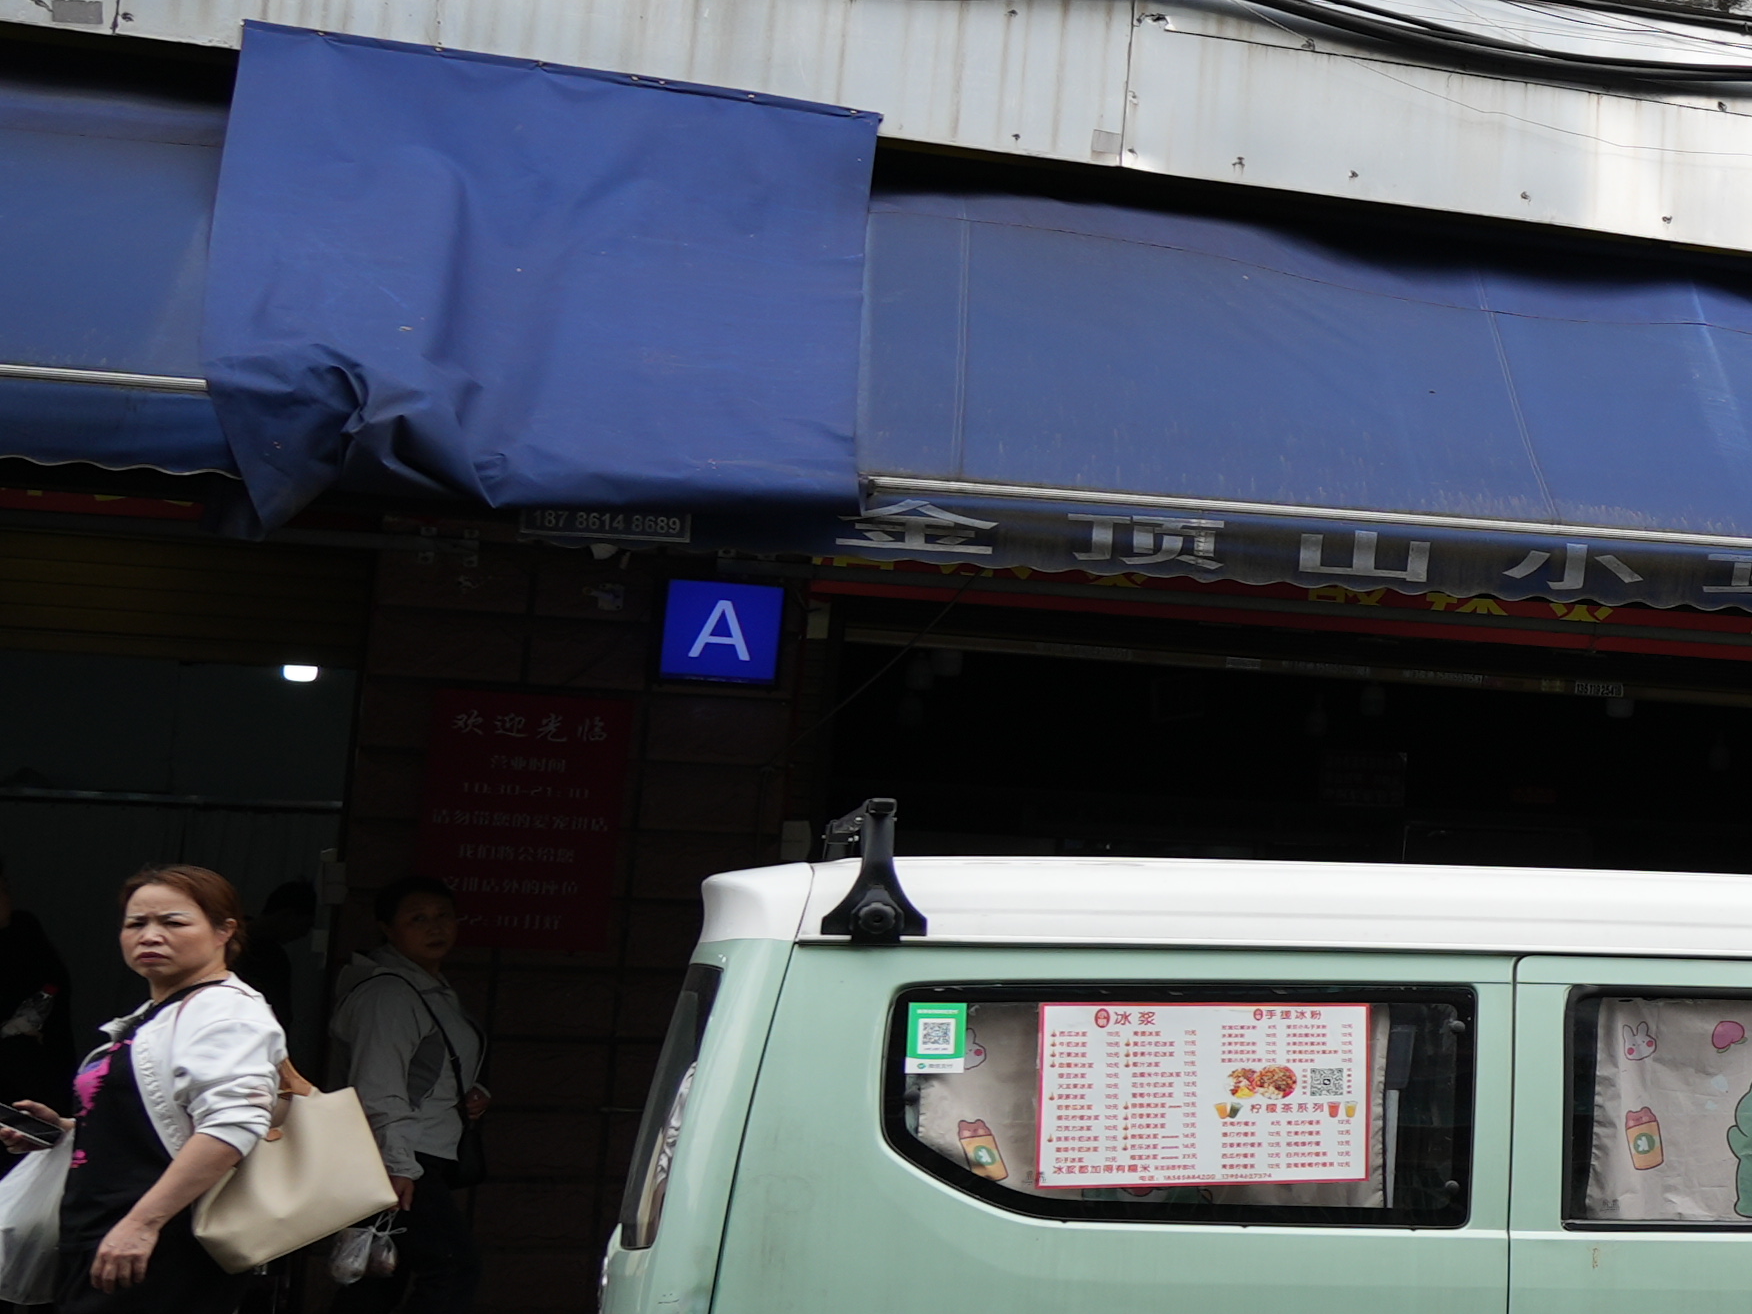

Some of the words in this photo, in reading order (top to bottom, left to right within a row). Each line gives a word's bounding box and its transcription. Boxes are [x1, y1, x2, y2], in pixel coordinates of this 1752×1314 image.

[532, 510, 568, 527] 187
[575, 511, 625, 531] 8614
[631, 514, 681, 534] 8689
[688, 598, 751, 662] A
[451, 709, 608, 742] 欢迎光临
[1114, 1011, 1156, 1025] 冰浆
[1250, 1103, 1325, 1113] 柠檬茶系列
